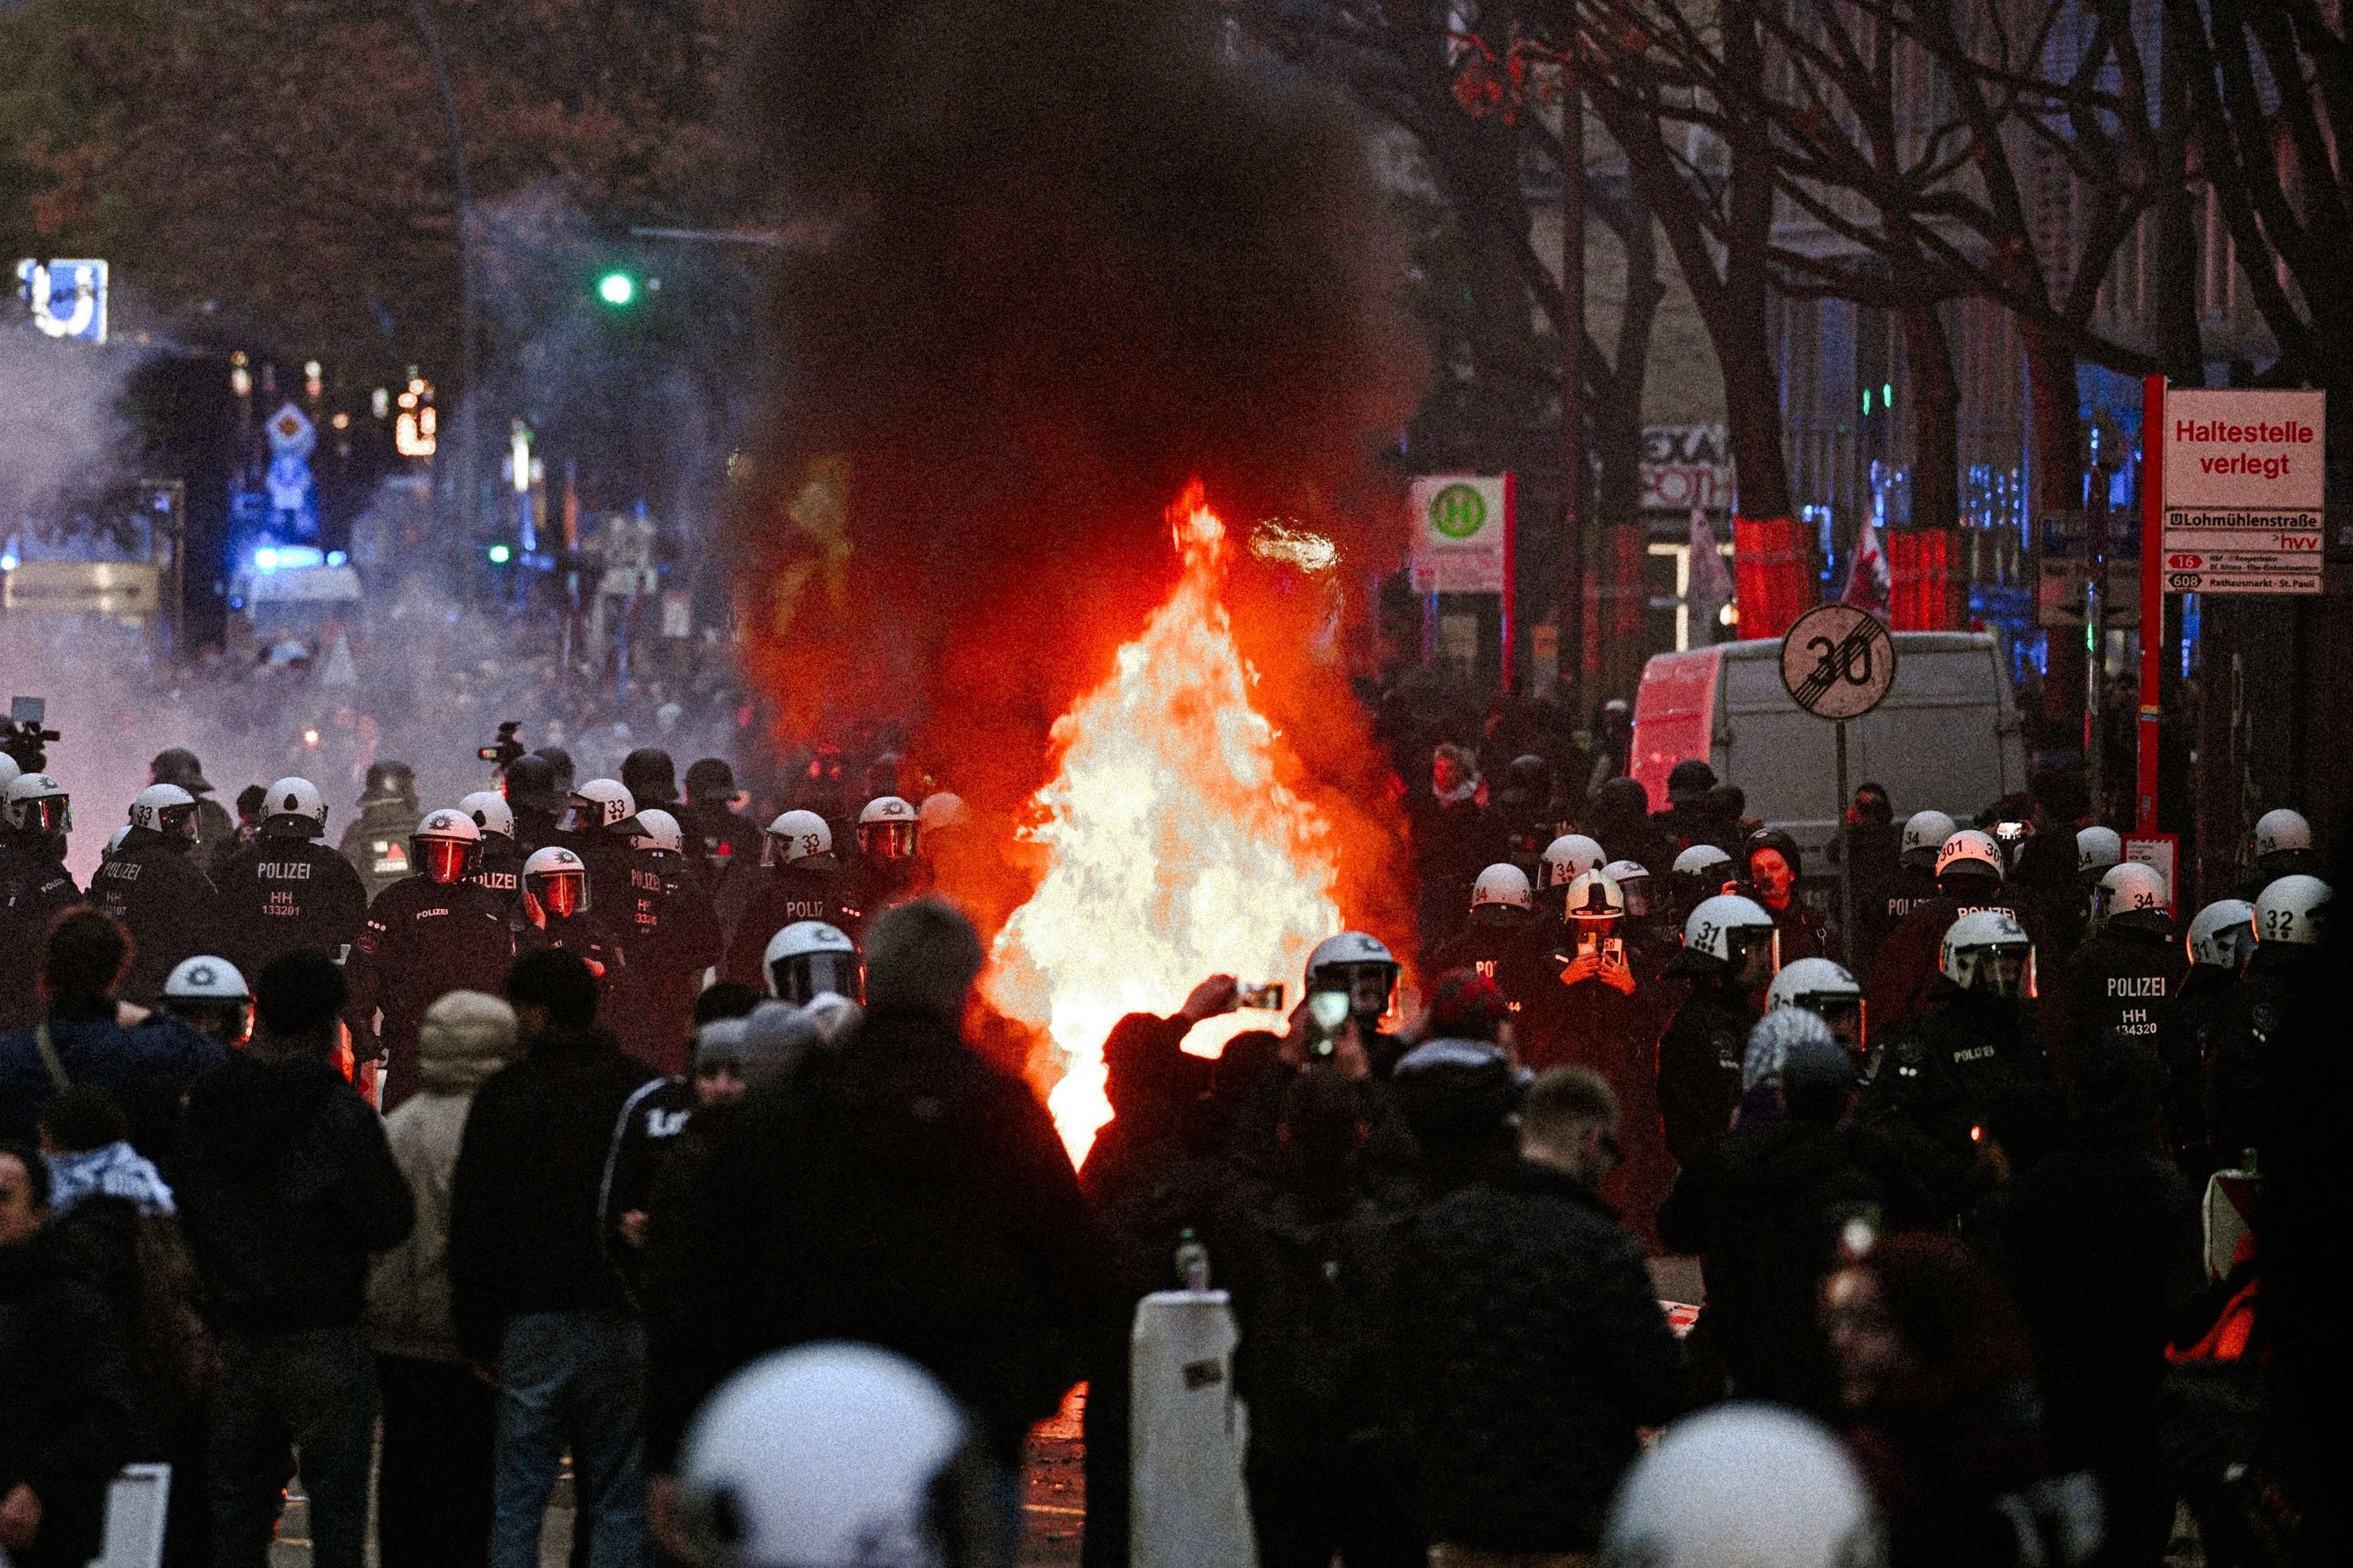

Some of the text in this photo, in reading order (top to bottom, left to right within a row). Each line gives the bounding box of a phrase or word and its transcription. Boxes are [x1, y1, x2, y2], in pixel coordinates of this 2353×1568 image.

[2177, 420, 2314, 443] Haltestelle
[2200, 453, 2290, 480] verlegt
[2184, 513, 2317, 527] Lohmühlenstraße
[2282, 535, 2317, 549] hvv
[2177, 555, 2194, 568] 16
[2173, 576, 2199, 587] 608
[2210, 579, 2272, 588] Rathausmarkt
[2292, 579, 2315, 588] Pauli
[1806, 635, 1872, 686] 30
[139, 805, 152, 820] 33
[608, 799, 625, 814] 33
[802, 834, 820, 848] 33
[1905, 832, 1919, 846] 34
[1941, 840, 1962, 862] 301
[103, 861, 141, 881] POLIZEI
[257, 863, 311, 880] POLIZEI
[1557, 861, 1575, 877] 34
[462, 871, 517, 890] OLIZEI
[270, 891, 293, 905] HH
[1474, 886, 1488, 902] 34
[2134, 891, 2155, 909] 34
[262, 905, 300, 916] 133201
[416, 908, 448, 920] POLIZEI
[2266, 910, 2293, 931] 32
[1697, 921, 1720, 943] 31
[2107, 977, 2166, 998] POLIZEI
[2122, 1008, 2147, 1024] HH
